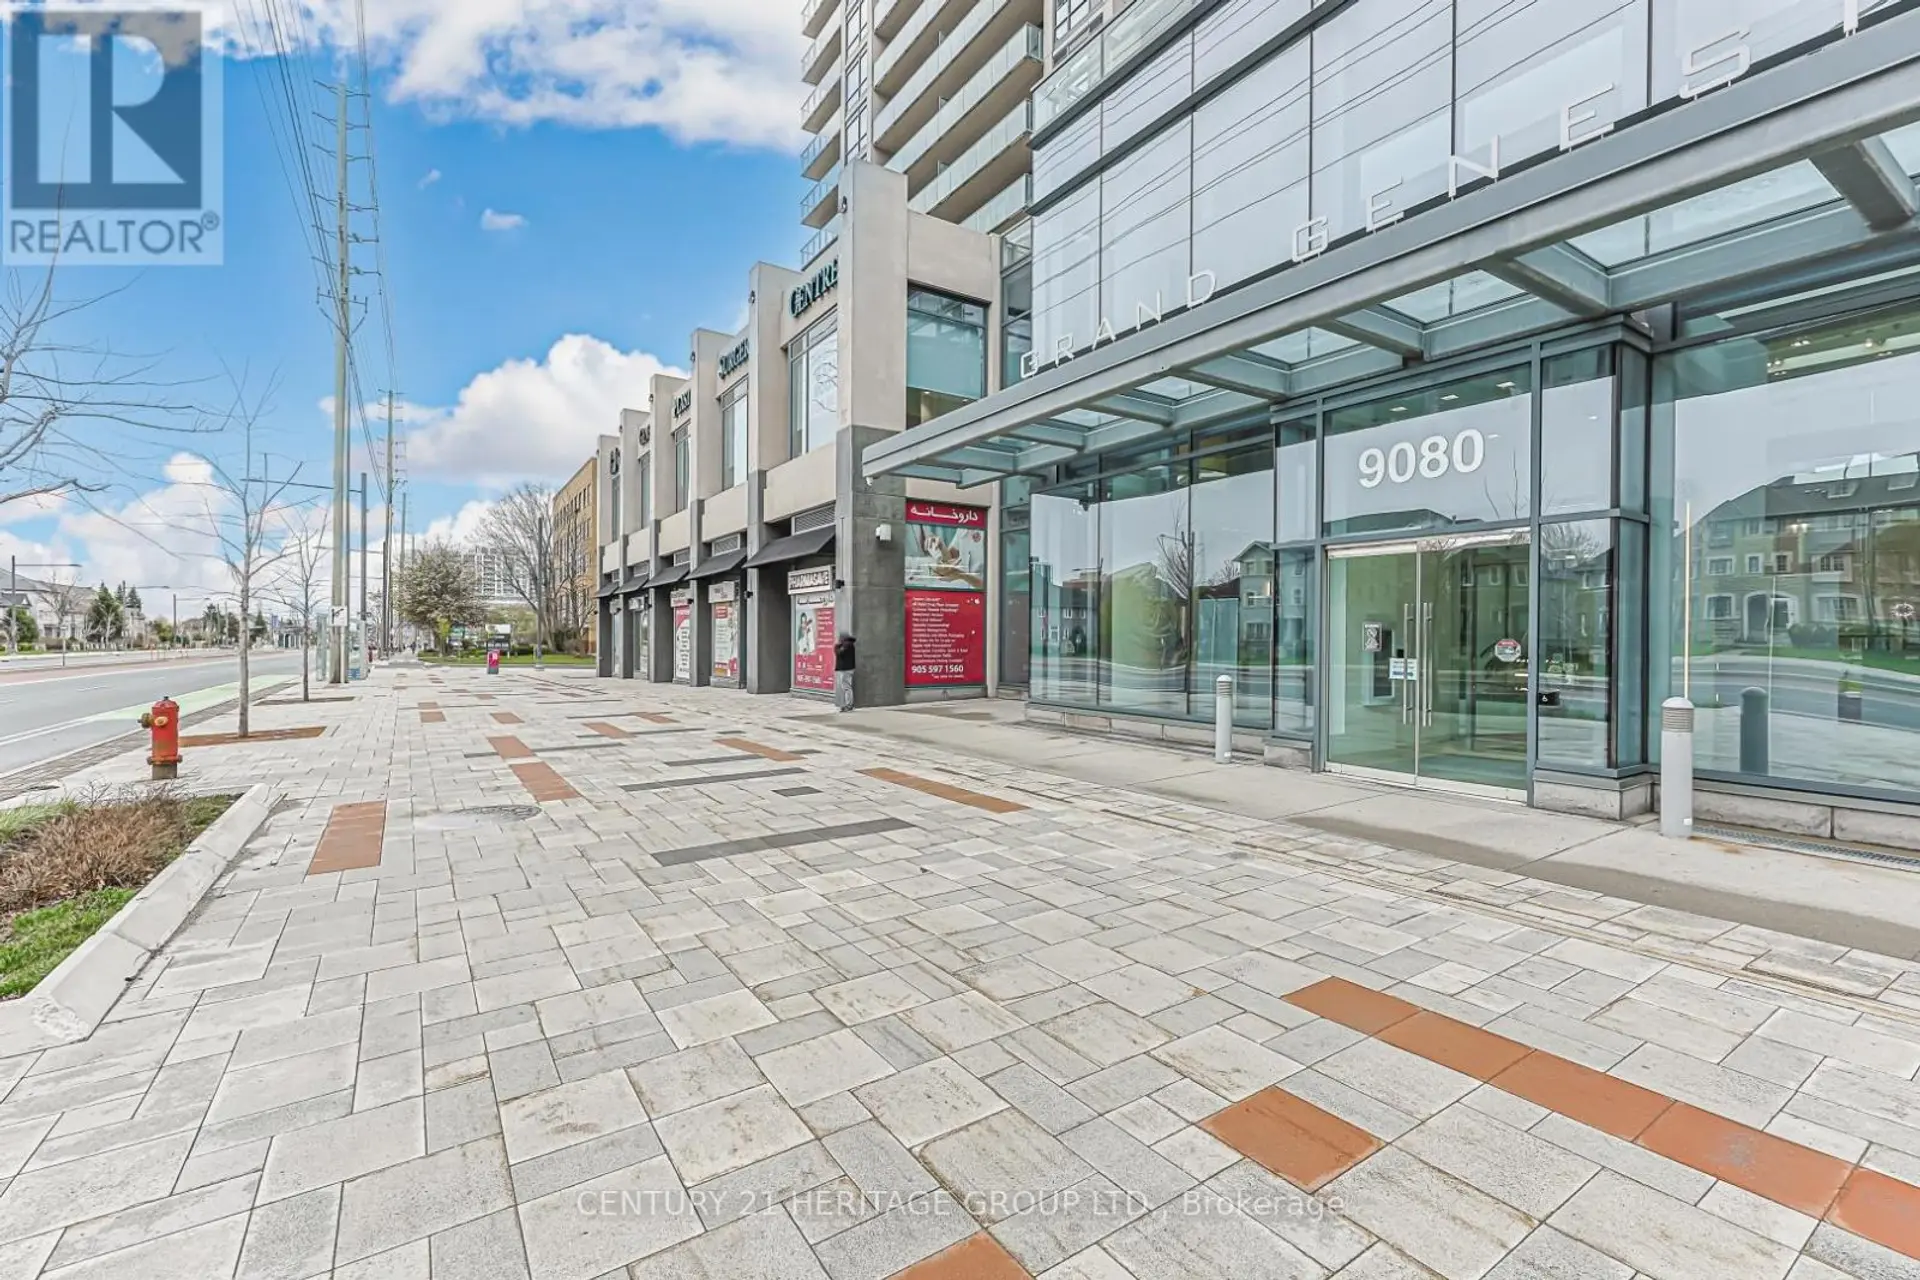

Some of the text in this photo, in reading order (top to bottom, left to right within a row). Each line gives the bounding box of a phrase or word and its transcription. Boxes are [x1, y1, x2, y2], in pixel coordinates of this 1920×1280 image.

[1020, 269, 1217, 379] GRAND
[1358, 428, 1486, 489] 9080
[911, 664, 964, 674] 905 597 1560
